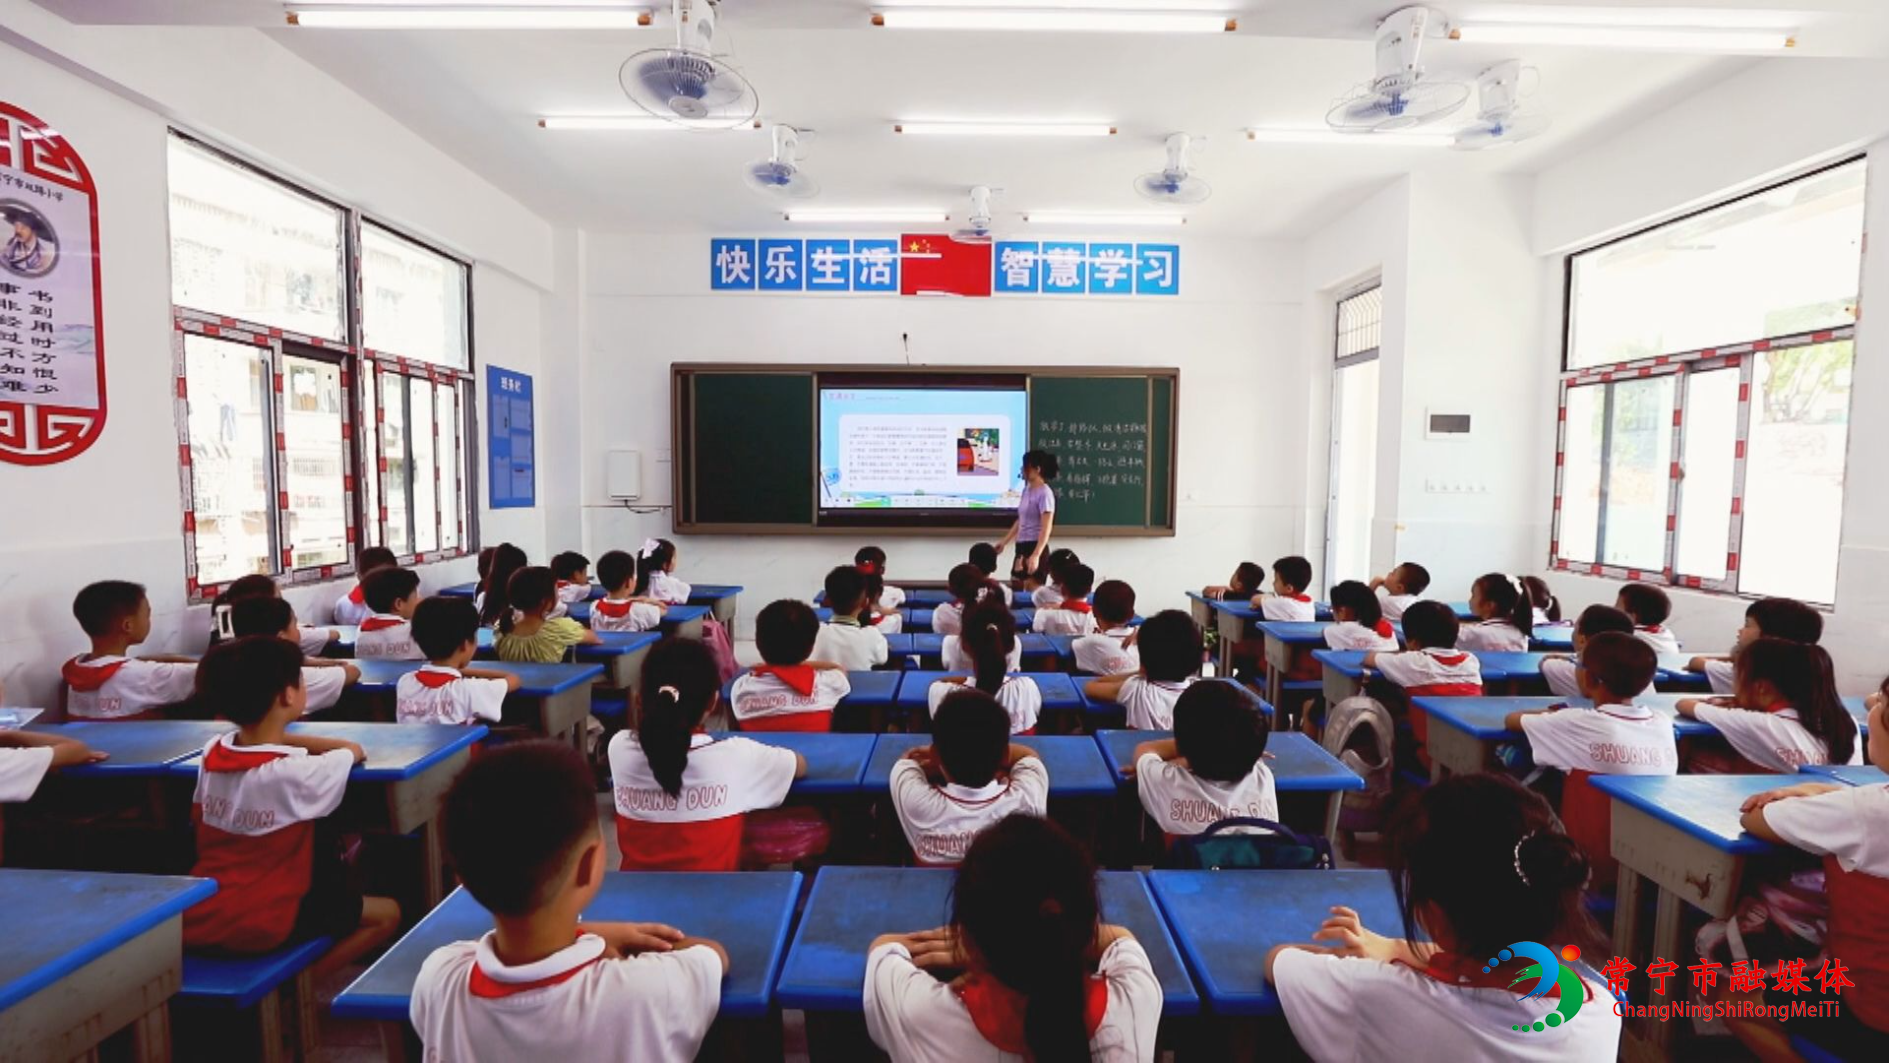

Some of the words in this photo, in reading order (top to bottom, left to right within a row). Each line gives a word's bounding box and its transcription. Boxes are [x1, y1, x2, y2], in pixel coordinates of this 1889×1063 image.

[716, 245, 891, 285] 快乐生活
[1001, 247, 1173, 288] 智慧学习
[28, 290, 58, 394] 书到用时方恨少
[1589, 743, 1662, 767] SHUANG
[686, 784, 728, 811] DUN
